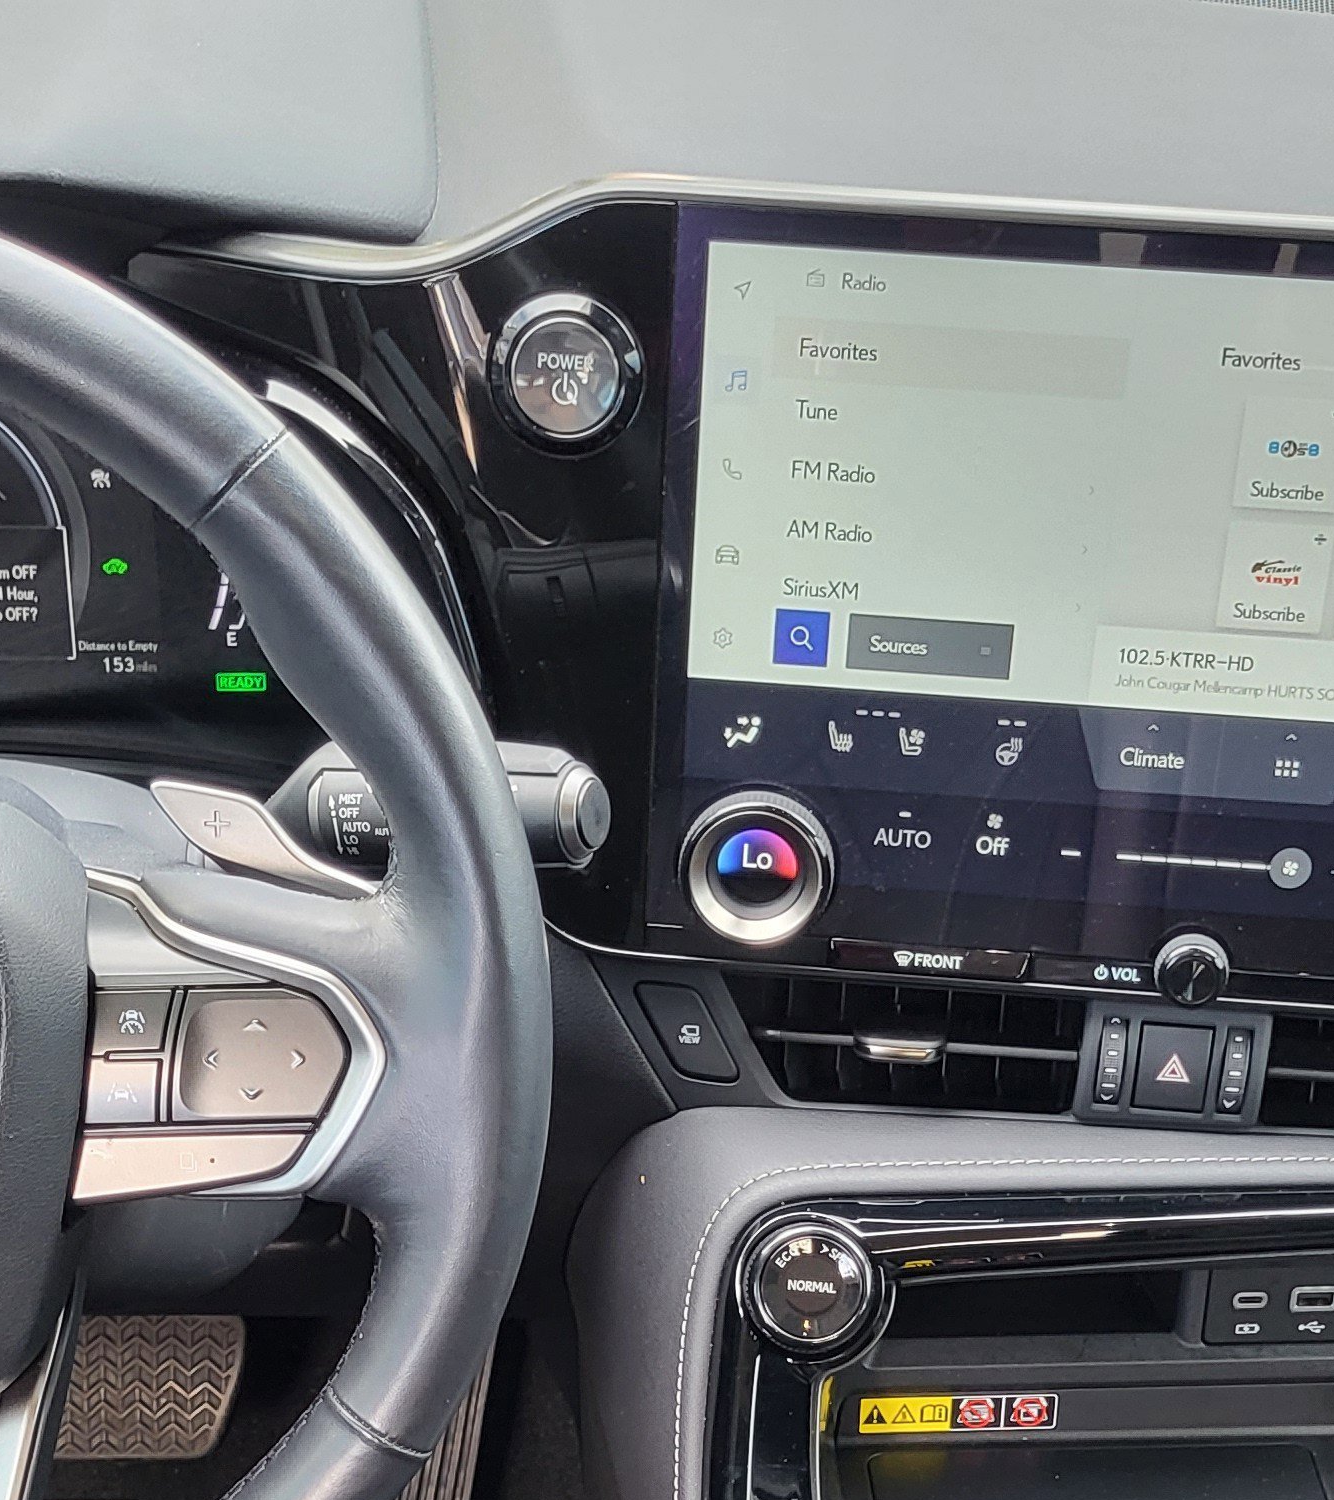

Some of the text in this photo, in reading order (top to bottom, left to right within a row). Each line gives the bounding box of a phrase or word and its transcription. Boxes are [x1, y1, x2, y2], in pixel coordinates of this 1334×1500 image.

[841, 272, 887, 293] Radio
[799, 337, 878, 362] Favorites
[537, 352, 594, 371] POWER
[1221, 347, 1302, 372] Favorites
[795, 399, 838, 421] Tune
[791, 460, 876, 484] FM Radio
[1250, 480, 1325, 502] Subscribe
[786, 519, 873, 544] AM Radio
[11, 564, 38, 581] OFF
[1254, 574, 1300, 587] vinyl
[6, 585, 39, 604] Hour,
[783, 577, 859, 601] SiriusXM
[4, 606, 39, 622] OFF?
[1233, 602, 1306, 623] Subscribe
[78, 640, 158, 653] Distance to Empty
[226, 631, 238, 647] E
[869, 635, 928, 656] Sources
[102, 656, 135, 673] 153
[1119, 648, 1165, 666] 102.5
[219, 676, 264, 689] READY
[1115, 674, 1145, 689] John
[1147, 677, 1191, 694] Cougar
[1193, 680, 1264, 699] Mellencamp
[1267, 685, 1314, 701] HURTS
[1120, 748, 1185, 770] Climate
[338, 793, 363, 805] MIST
[338, 807, 360, 819] OFF
[342, 821, 371, 833] AUTO
[873, 828, 932, 850] AUTO
[975, 836, 1009, 857] Off
[741, 842, 773, 870] Lo
[913, 952, 964, 971] FRONT
[1110, 966, 1142, 983] VOL
[678, 1035, 701, 1045] VIEW
[787, 1279, 837, 1294] NORMAL
